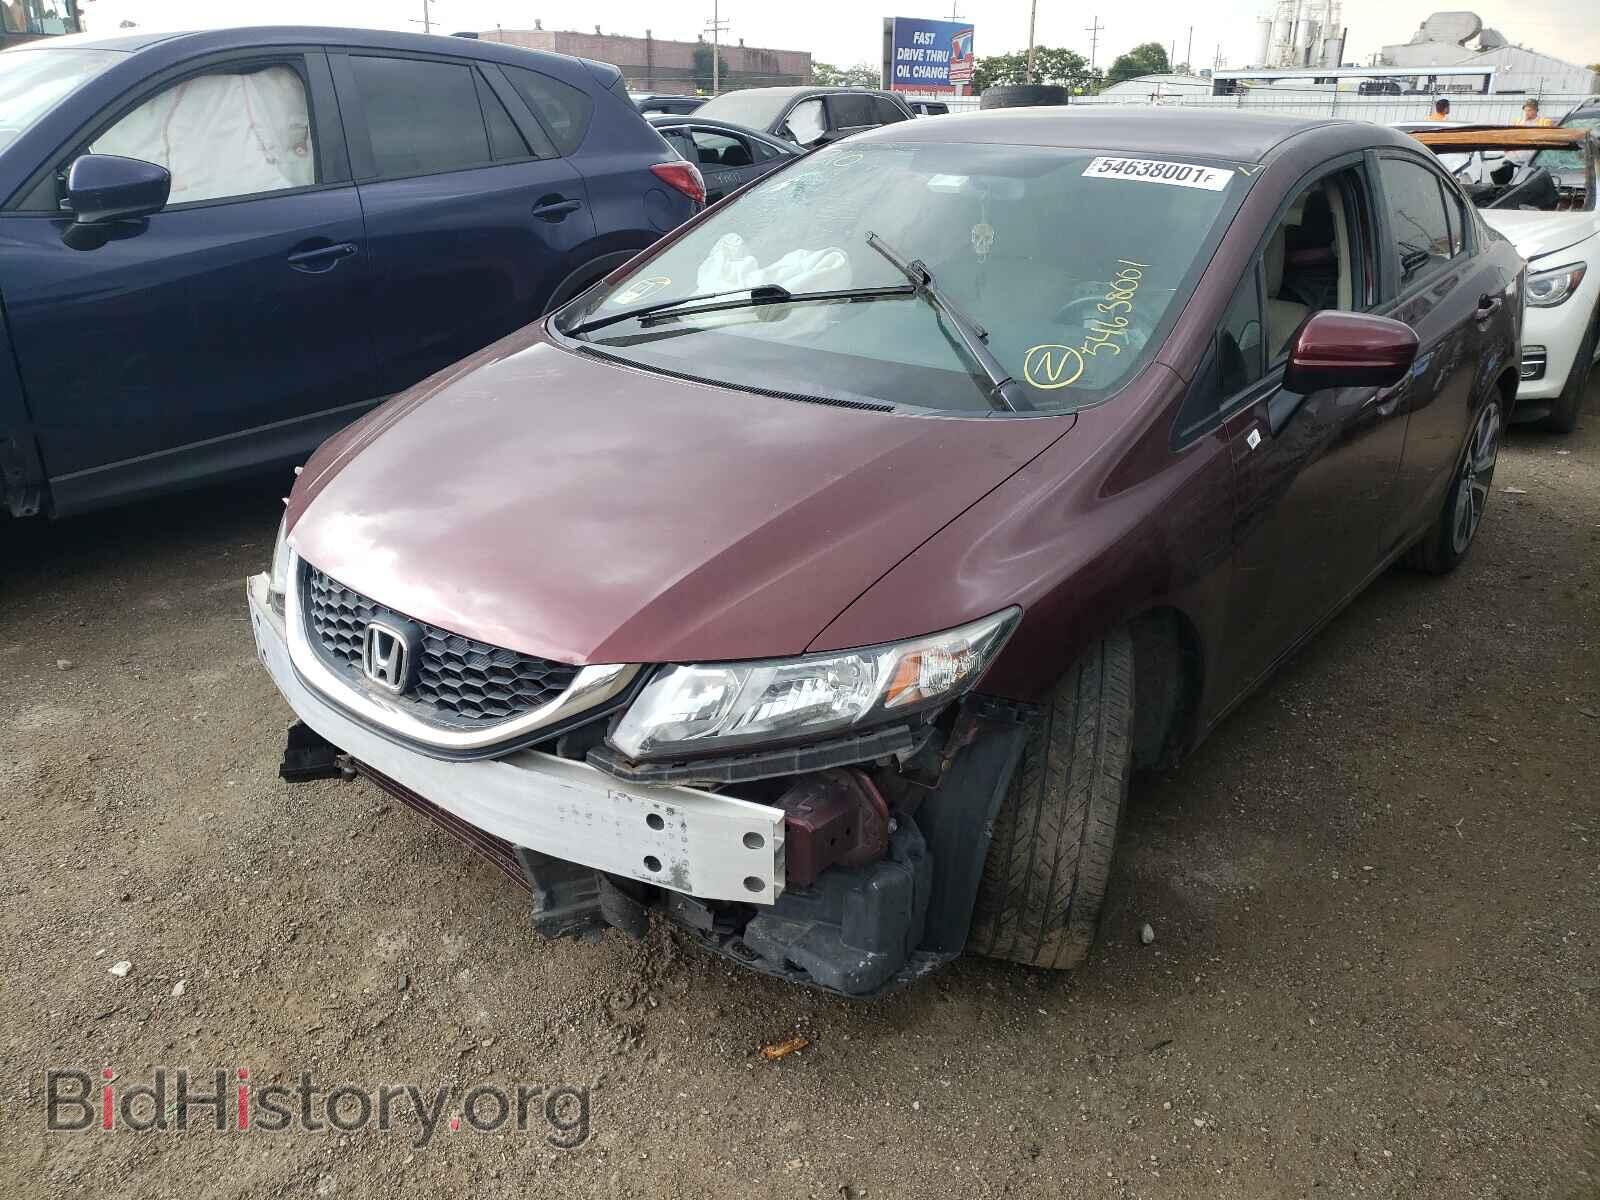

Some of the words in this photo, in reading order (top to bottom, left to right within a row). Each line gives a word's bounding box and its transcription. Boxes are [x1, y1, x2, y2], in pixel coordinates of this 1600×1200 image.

[913, 32, 936, 45] FAST
[897, 48, 924, 61] DRIVE
[926, 50, 949, 63] THRU
[896, 65, 911, 78] OIL
[912, 66, 949, 79] CHANGE
[1081, 259, 1152, 355] 54638001
